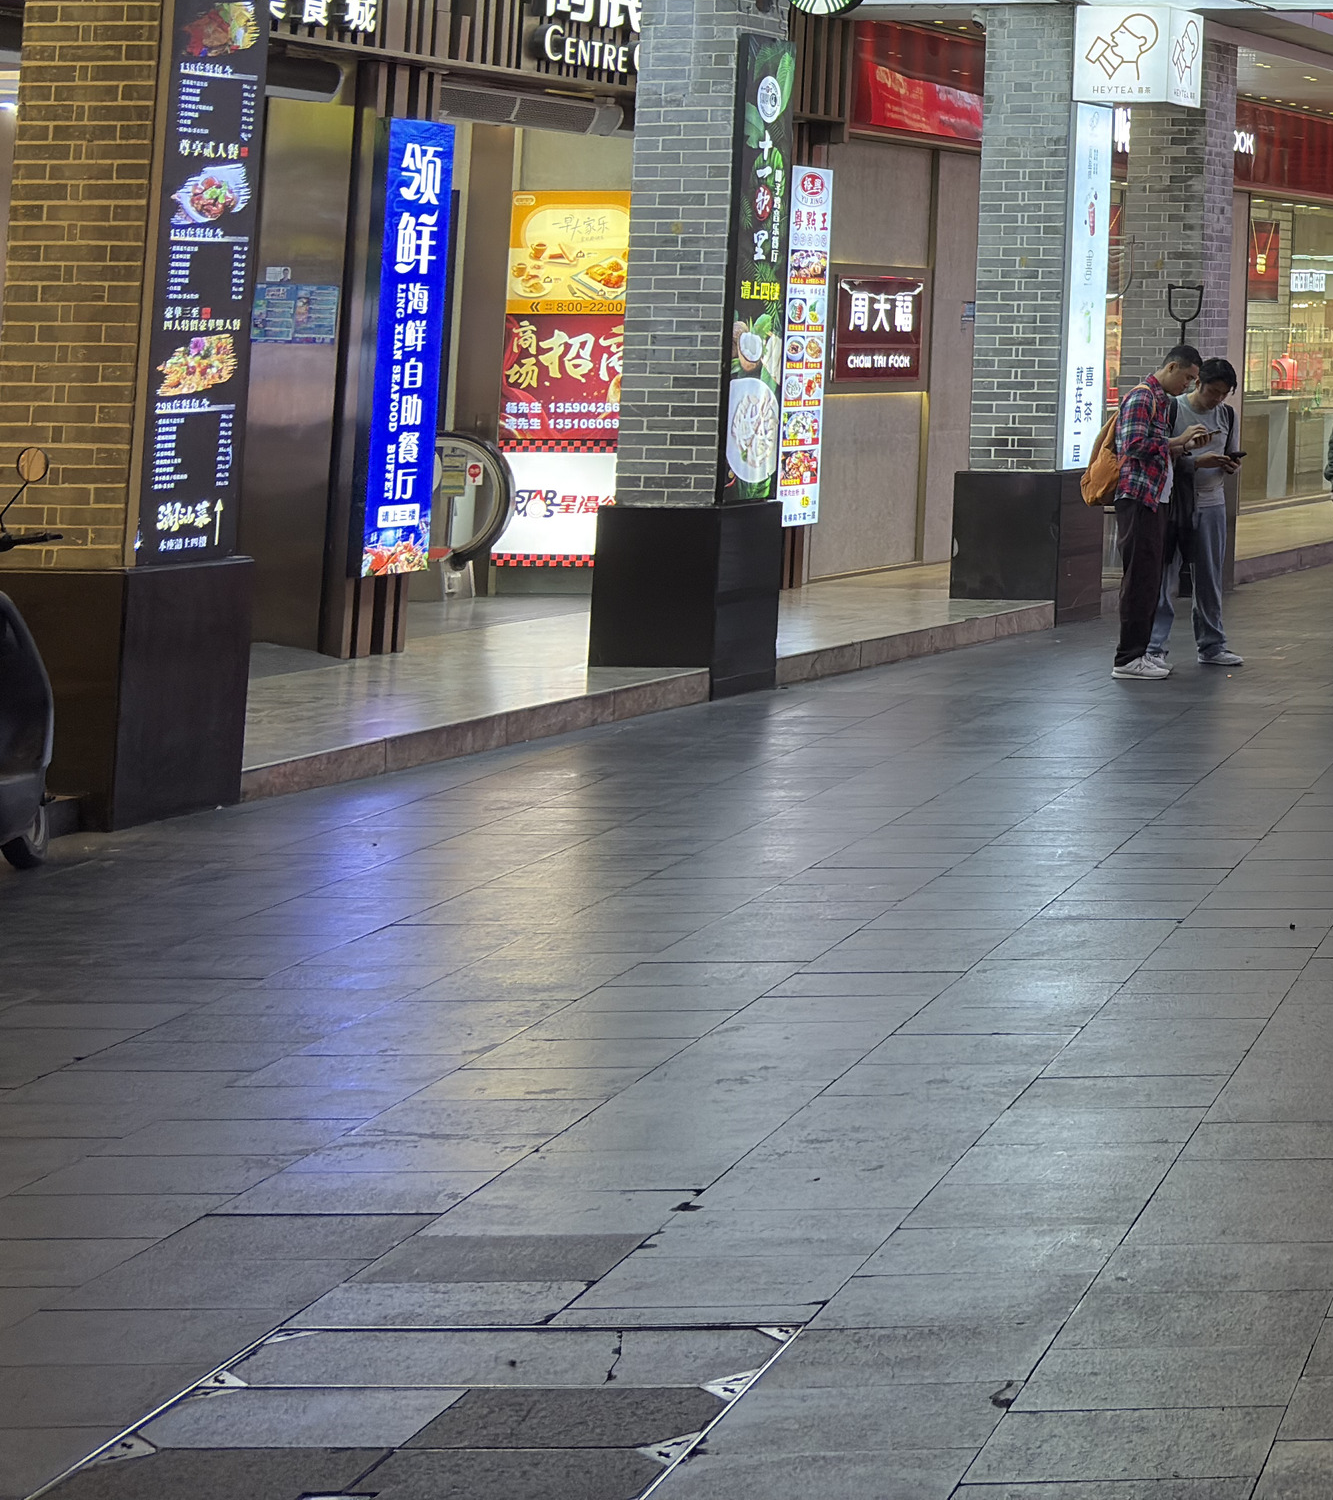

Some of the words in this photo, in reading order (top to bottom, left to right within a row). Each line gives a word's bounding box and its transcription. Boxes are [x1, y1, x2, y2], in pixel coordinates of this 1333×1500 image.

[544, 24, 628, 73] CENTRE
[1092, 85, 1134, 95] HEYTEA
[394, 142, 444, 275] 领鲜
[751, 132, 773, 263] 十一歌里
[395, 282, 407, 319] LING
[556, 300, 623, 313] 8:00-22:00
[740, 279, 780, 301] 请上四楼
[848, 293, 914, 334] 周大福
[393, 323, 404, 361] XIAN
[847, 354, 873, 370] CHOW
[874, 354, 888, 369] TAI
[889, 354, 911, 369] FOOK
[388, 365, 401, 433] SEAFOOD
[393, 282, 430, 501] 海鲜自助餐厅
[1085, 365, 1095, 423] 喜茶
[1071, 365, 1083, 464] 就在负一层
[382, 443, 396, 500] BUFFET
[381, 507, 417, 523] 请上三楼
